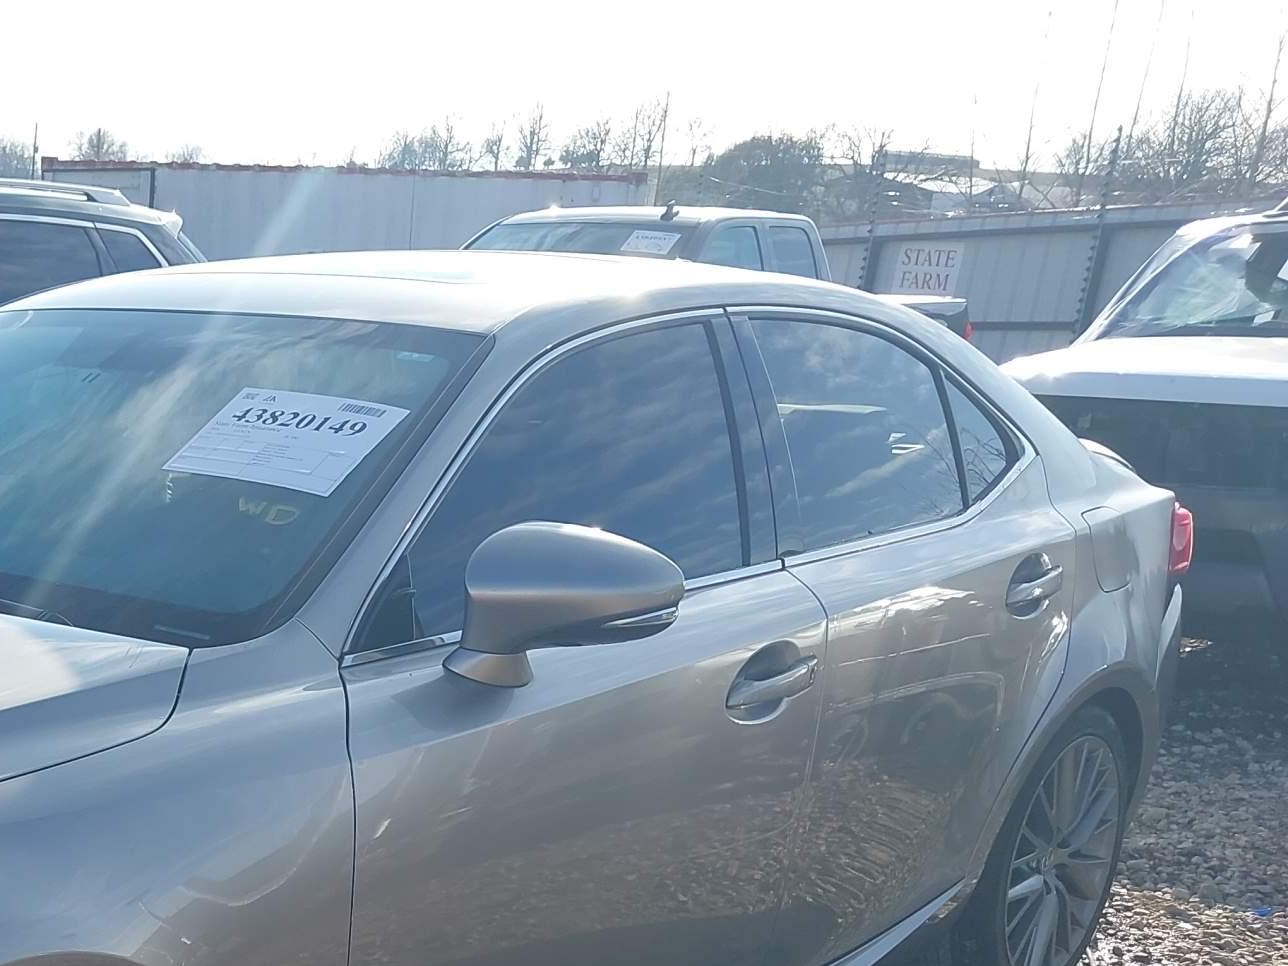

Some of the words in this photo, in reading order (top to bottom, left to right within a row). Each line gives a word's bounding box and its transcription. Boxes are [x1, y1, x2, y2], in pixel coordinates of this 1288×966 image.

[902, 248, 957, 268] STATE
[899, 271, 949, 291] FARM
[232, 407, 368, 436] 43820149
